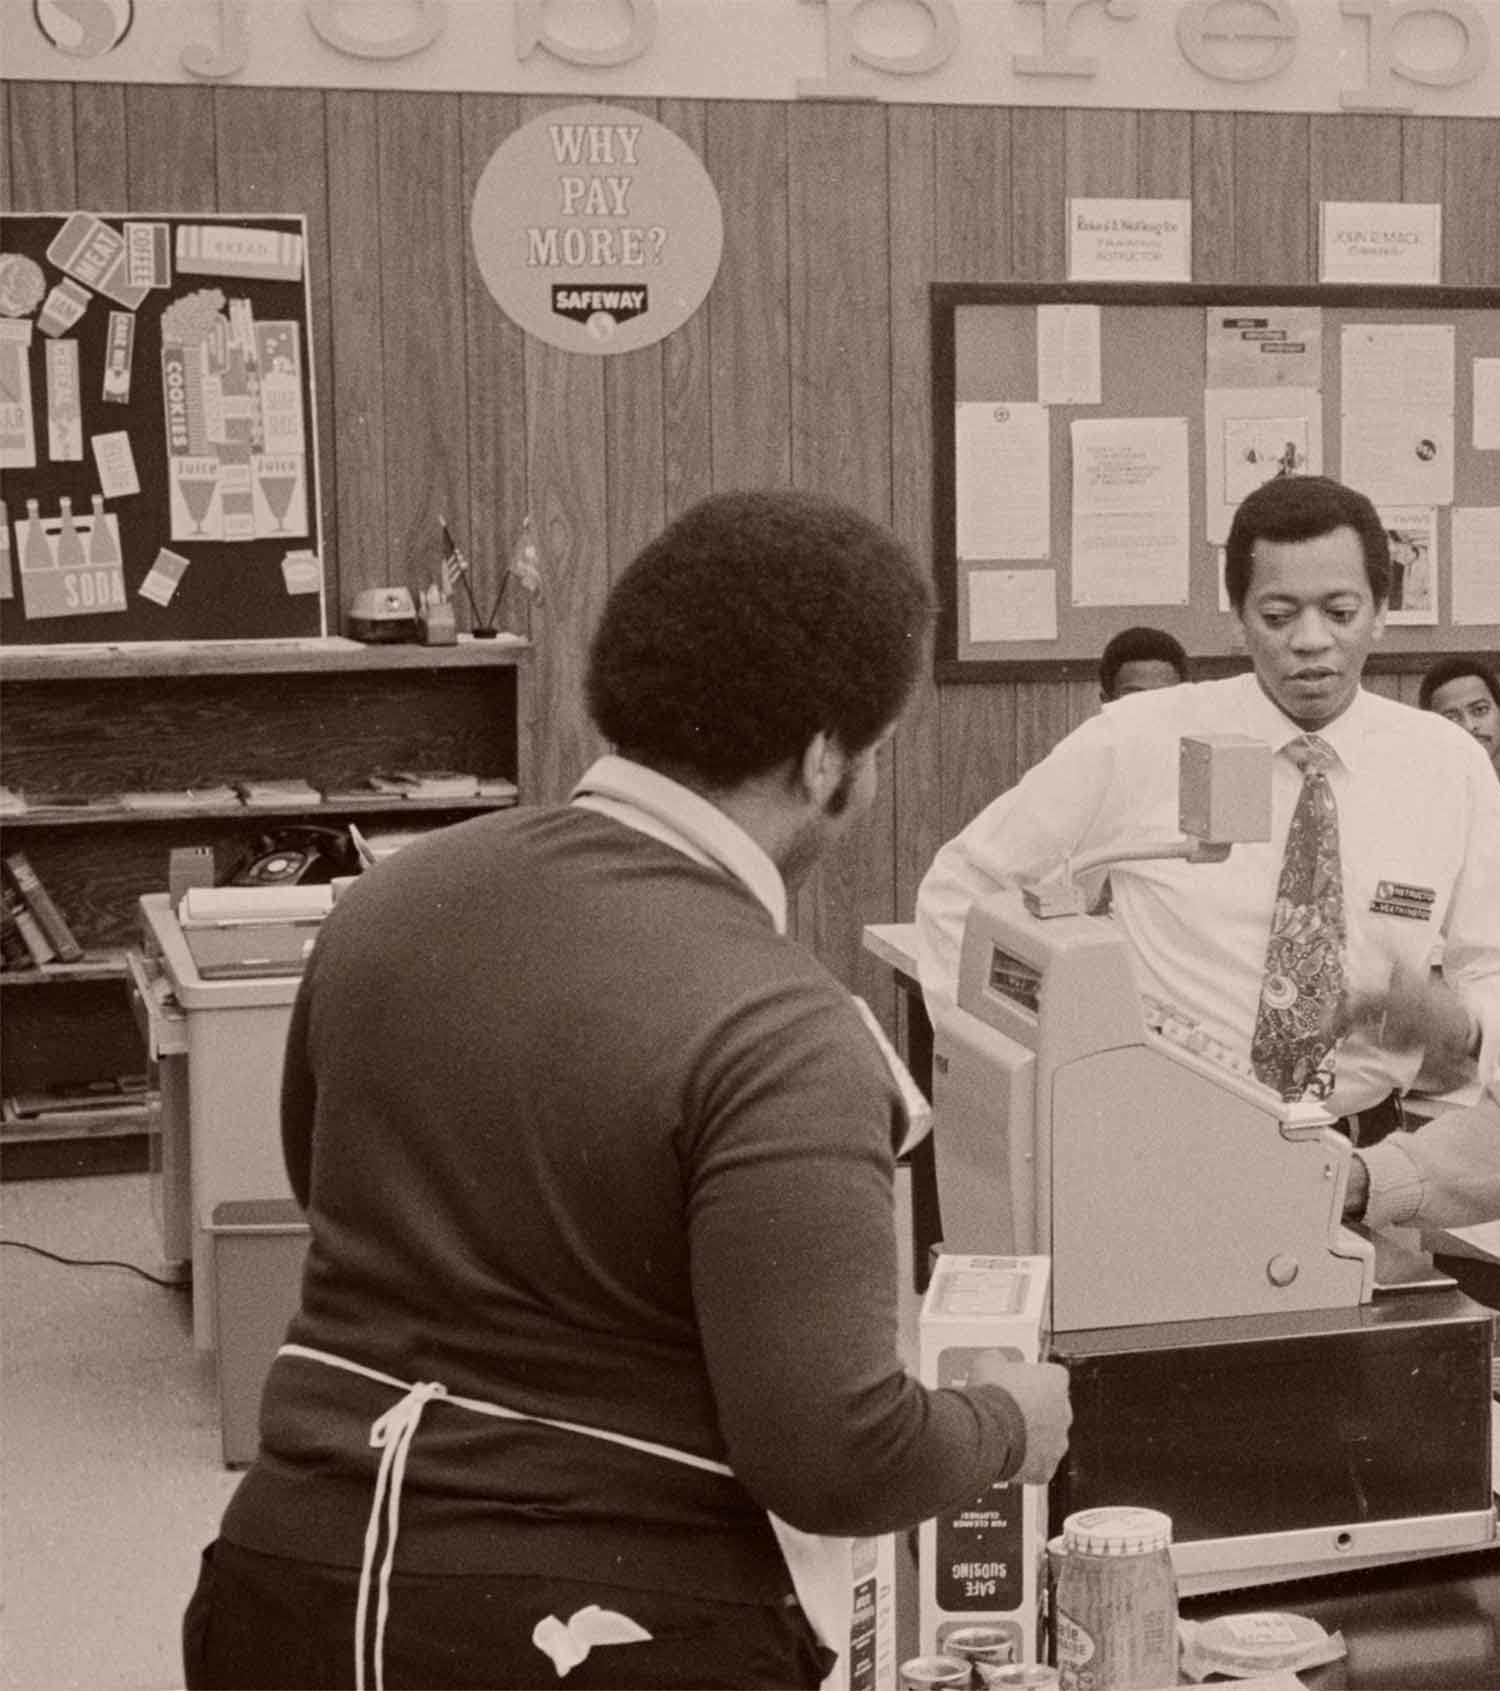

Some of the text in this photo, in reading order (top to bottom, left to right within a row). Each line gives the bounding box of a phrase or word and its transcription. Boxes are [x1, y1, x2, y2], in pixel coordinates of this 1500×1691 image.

[548, 123, 643, 168] WHY
[559, 176, 630, 217] PAY
[76, 231, 120, 282] MEAT
[132, 227, 153, 287] COFFEE
[526, 226, 668, 269] MORE?
[555, 288, 645, 312] SAFEWAY
[166, 361, 188, 447] COOKIES
[64, 567, 125, 609] SODA
[952, 1563, 1007, 1579] SUDSING
[965, 1580, 996, 1597] SAFE
